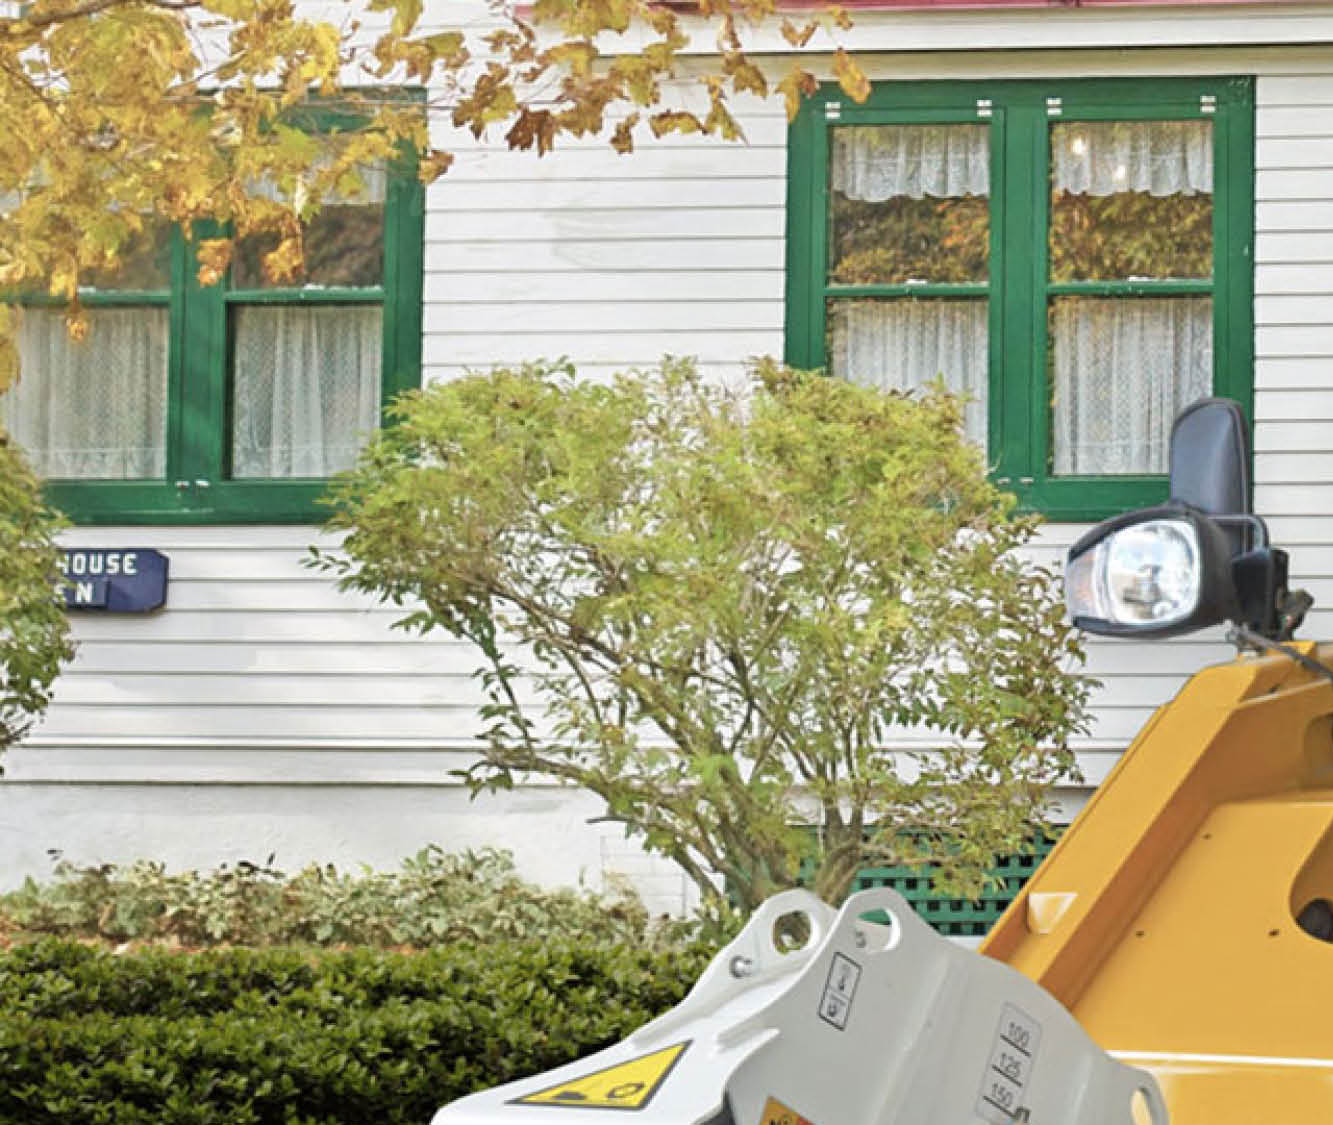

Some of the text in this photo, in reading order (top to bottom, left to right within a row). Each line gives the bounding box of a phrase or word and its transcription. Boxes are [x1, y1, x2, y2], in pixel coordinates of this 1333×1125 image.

[1008, 1022, 1030, 1047] 100
[1000, 1052, 1021, 1078] 125
[992, 1082, 1014, 1108] 150
